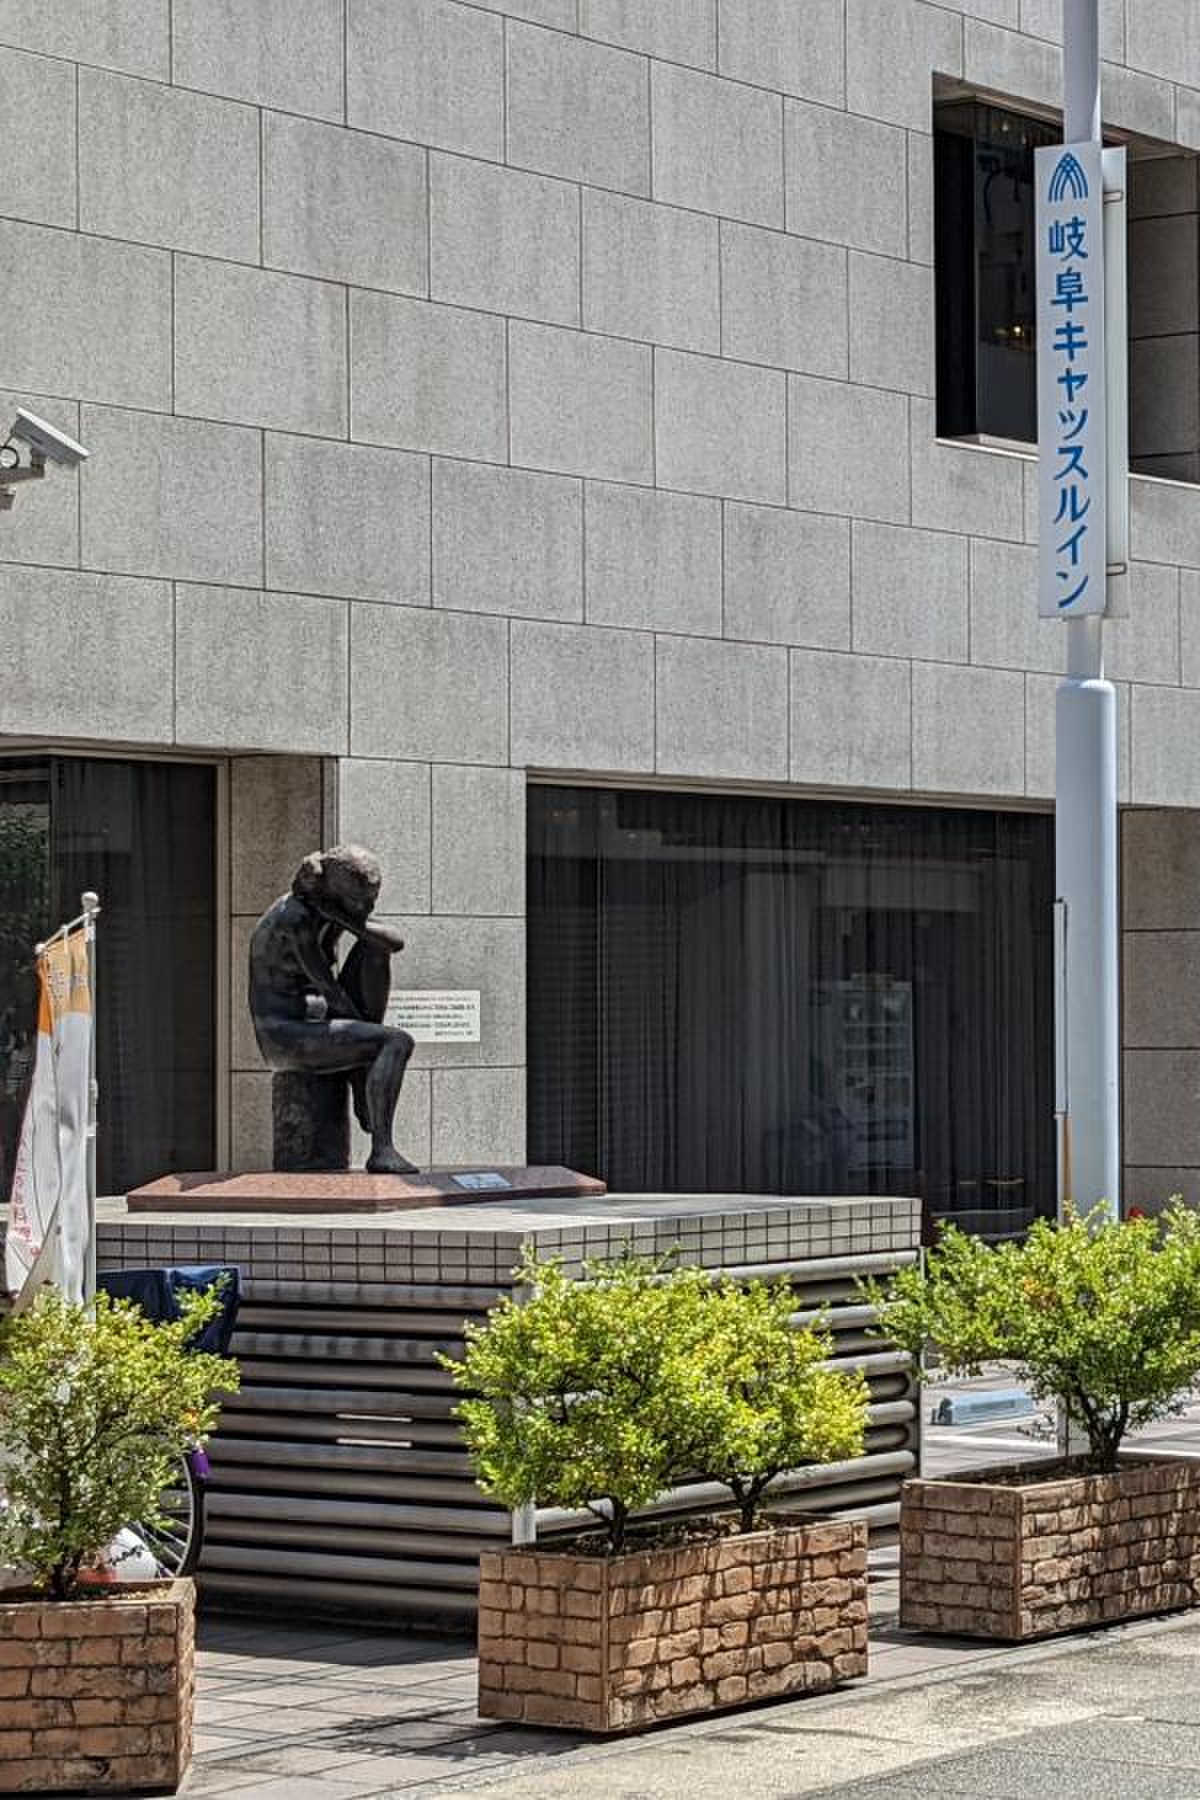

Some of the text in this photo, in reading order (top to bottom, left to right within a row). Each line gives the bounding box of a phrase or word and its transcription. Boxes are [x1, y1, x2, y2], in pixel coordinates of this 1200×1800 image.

[1048, 215, 1091, 609] 岐阜キャッスルイン
